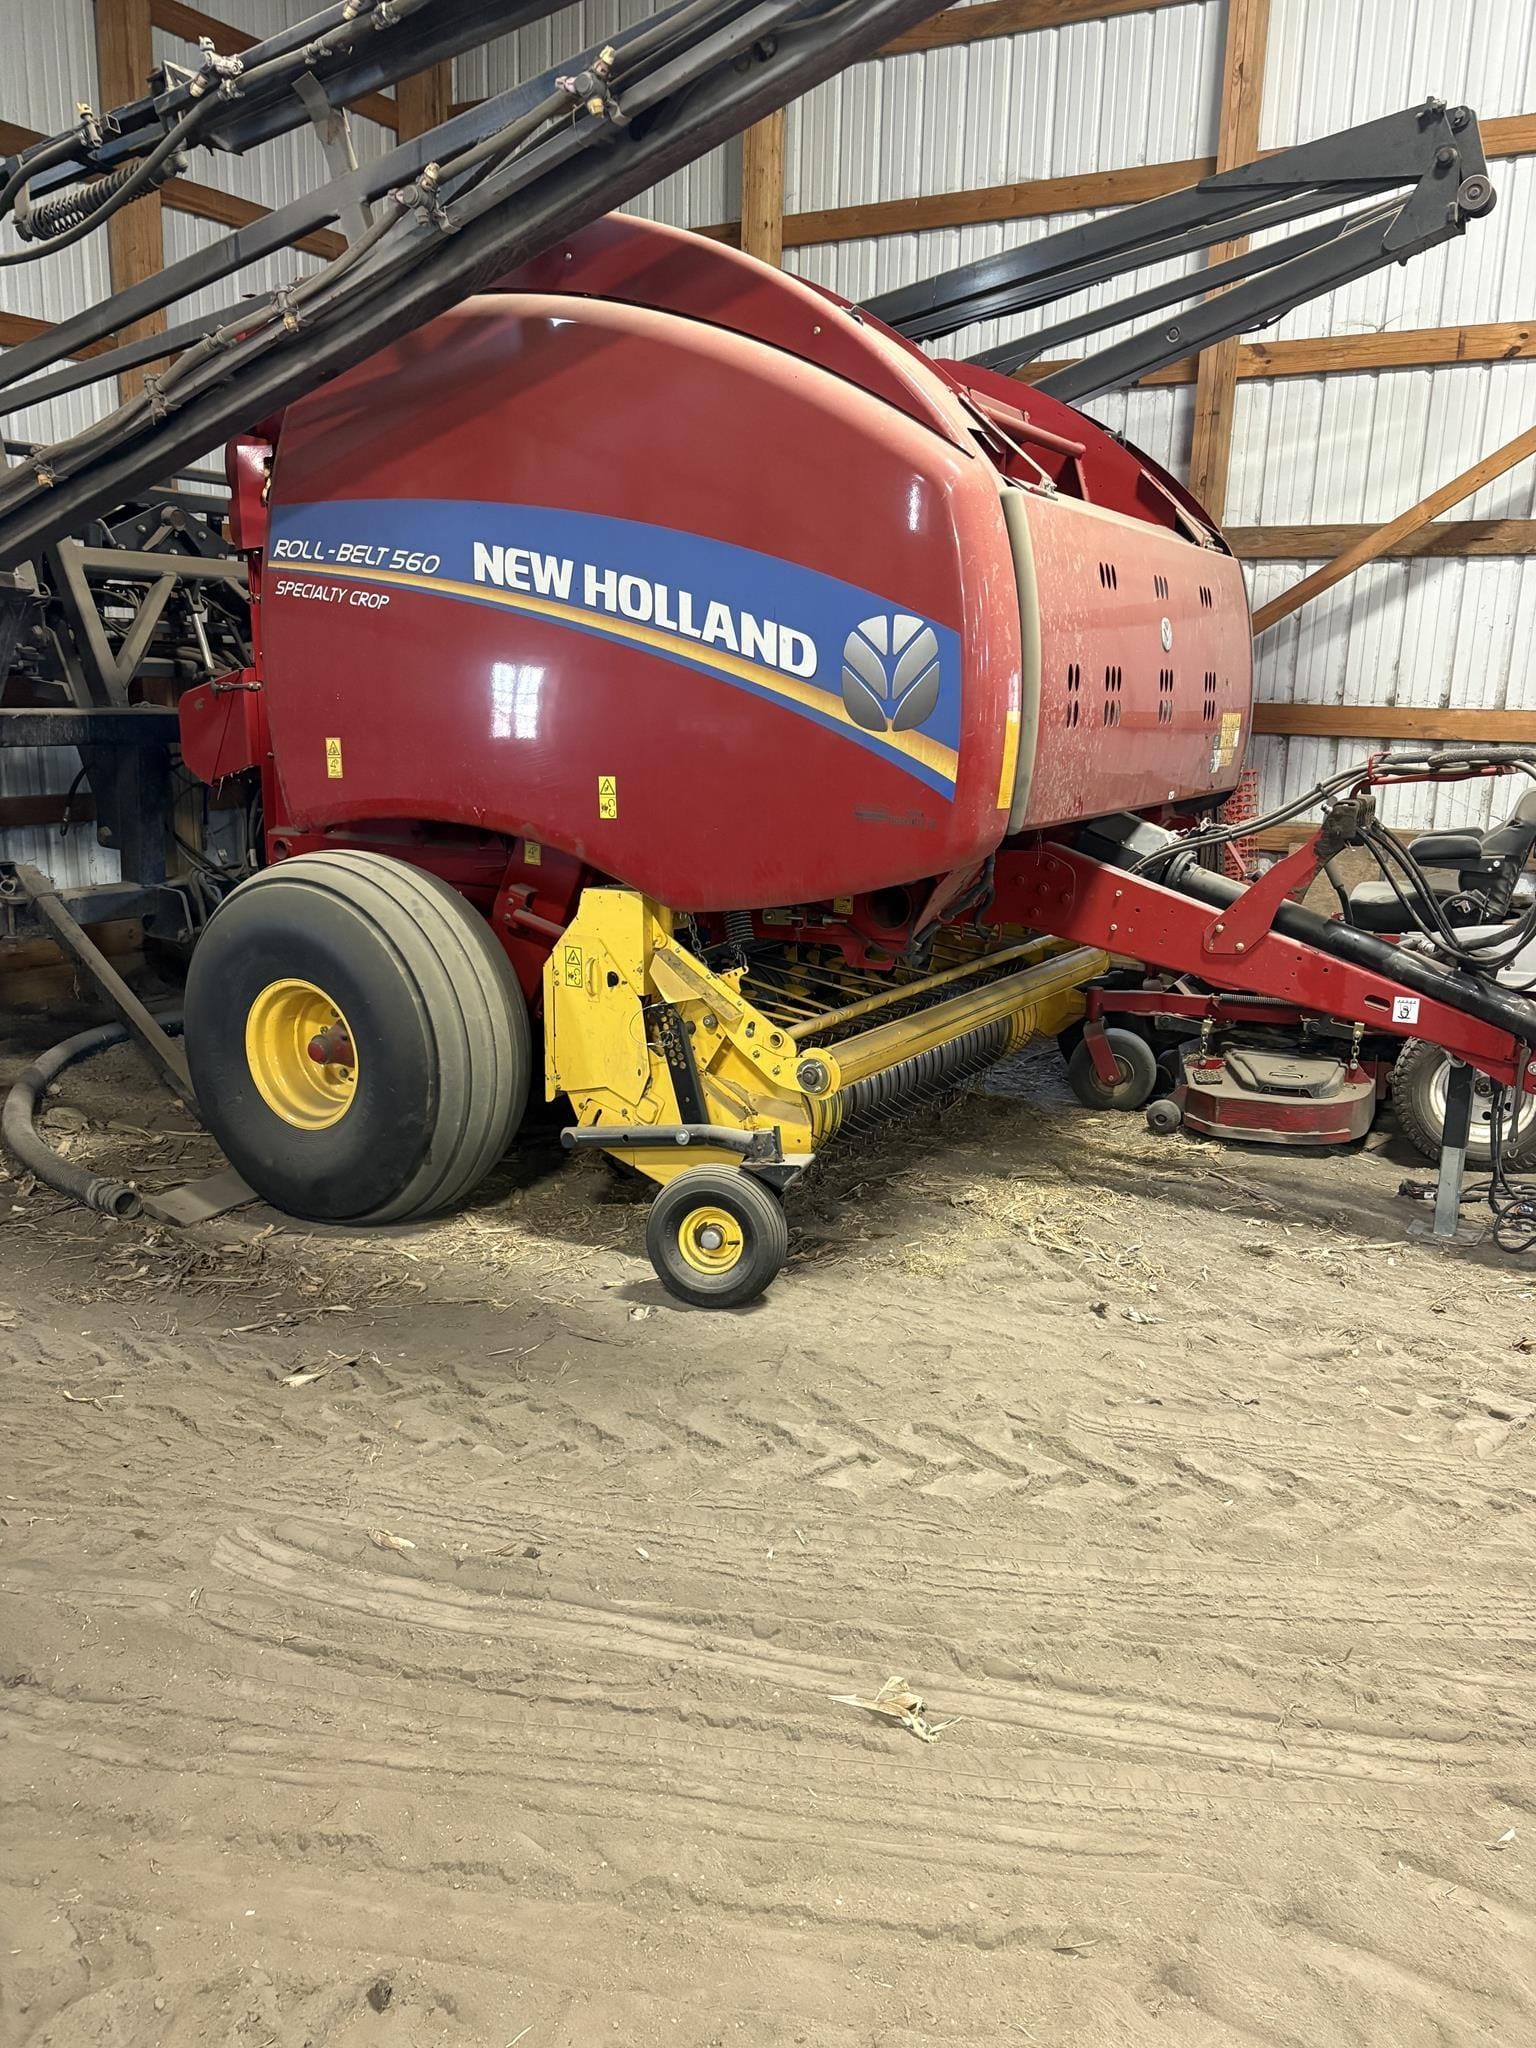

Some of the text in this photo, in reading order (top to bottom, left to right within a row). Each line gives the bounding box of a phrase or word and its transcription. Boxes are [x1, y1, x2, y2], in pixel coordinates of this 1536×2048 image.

[273, 539, 440, 574] ROLL-BELT 560
[275, 580, 389, 609] SPECIALTY CROP
[473, 541, 818, 678] NEW HOLLAND
